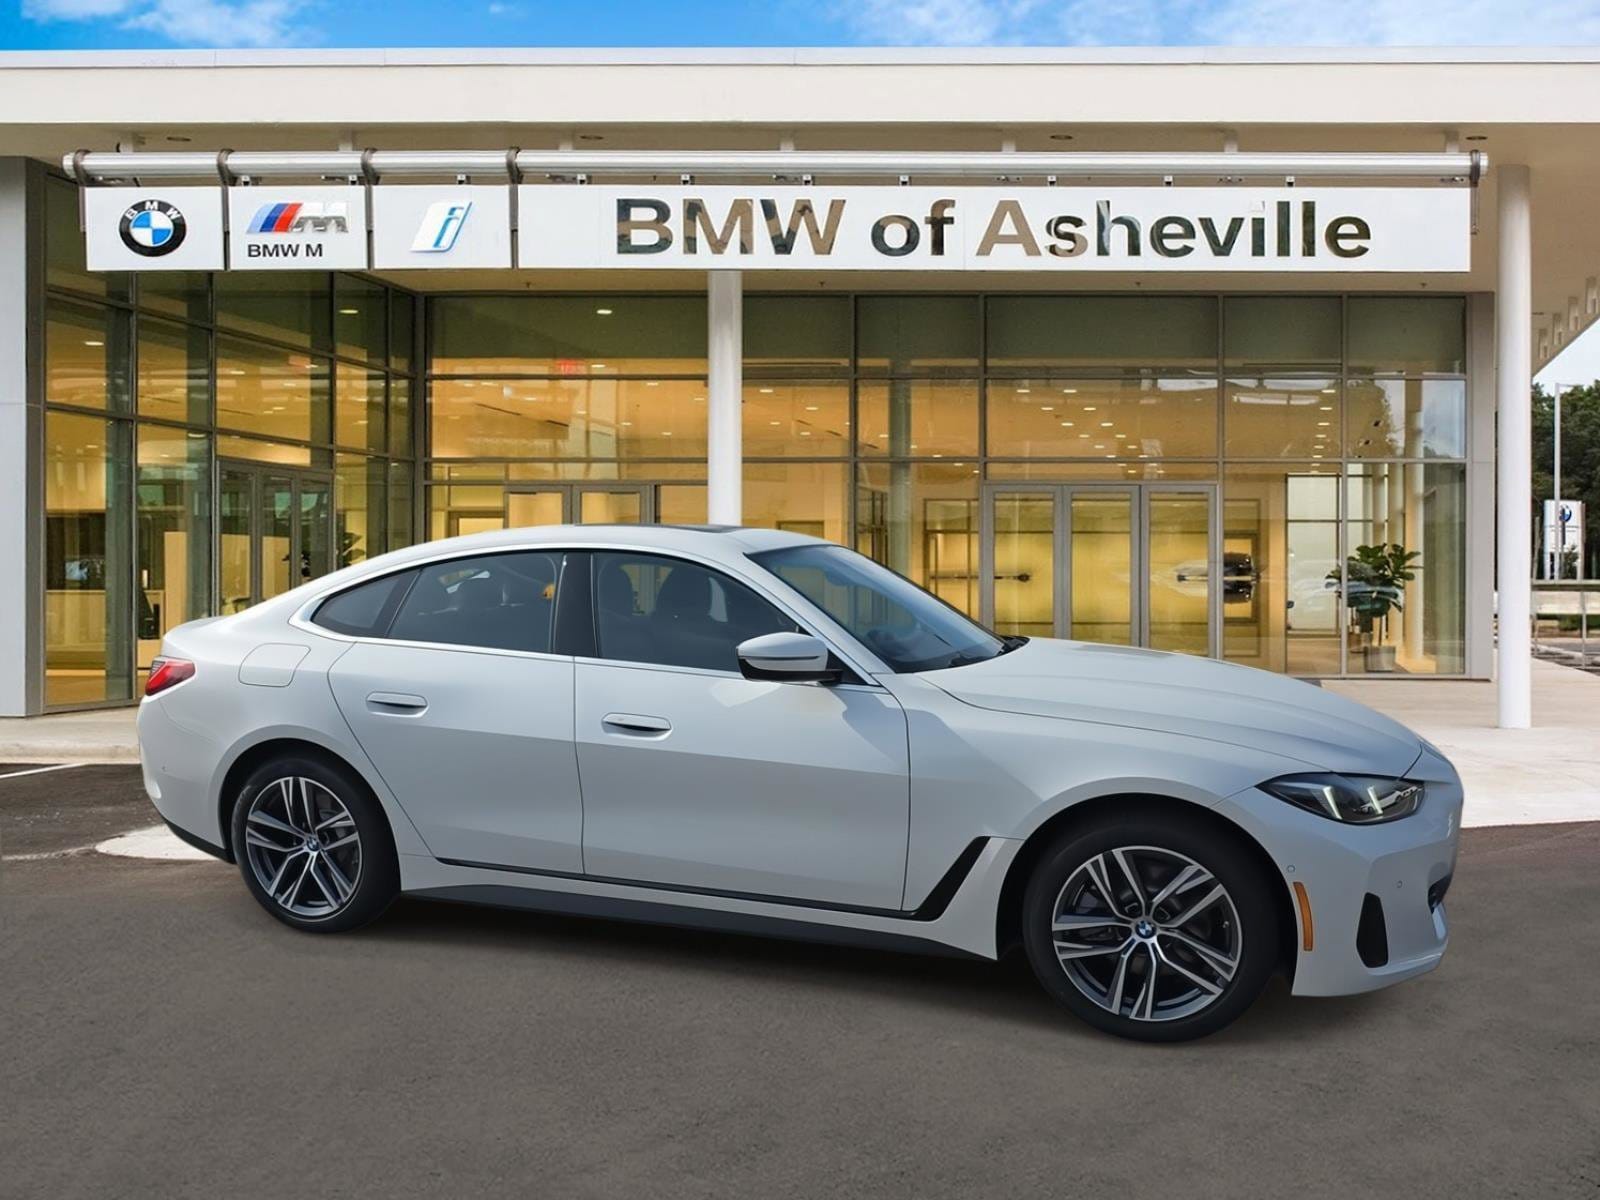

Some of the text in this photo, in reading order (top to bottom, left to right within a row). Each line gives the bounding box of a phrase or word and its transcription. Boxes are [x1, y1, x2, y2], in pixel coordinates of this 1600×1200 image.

[125, 201, 181, 220] BMW
[616, 198, 1372, 258] BMW of Asheville
[247, 243, 323, 258] BMW M
